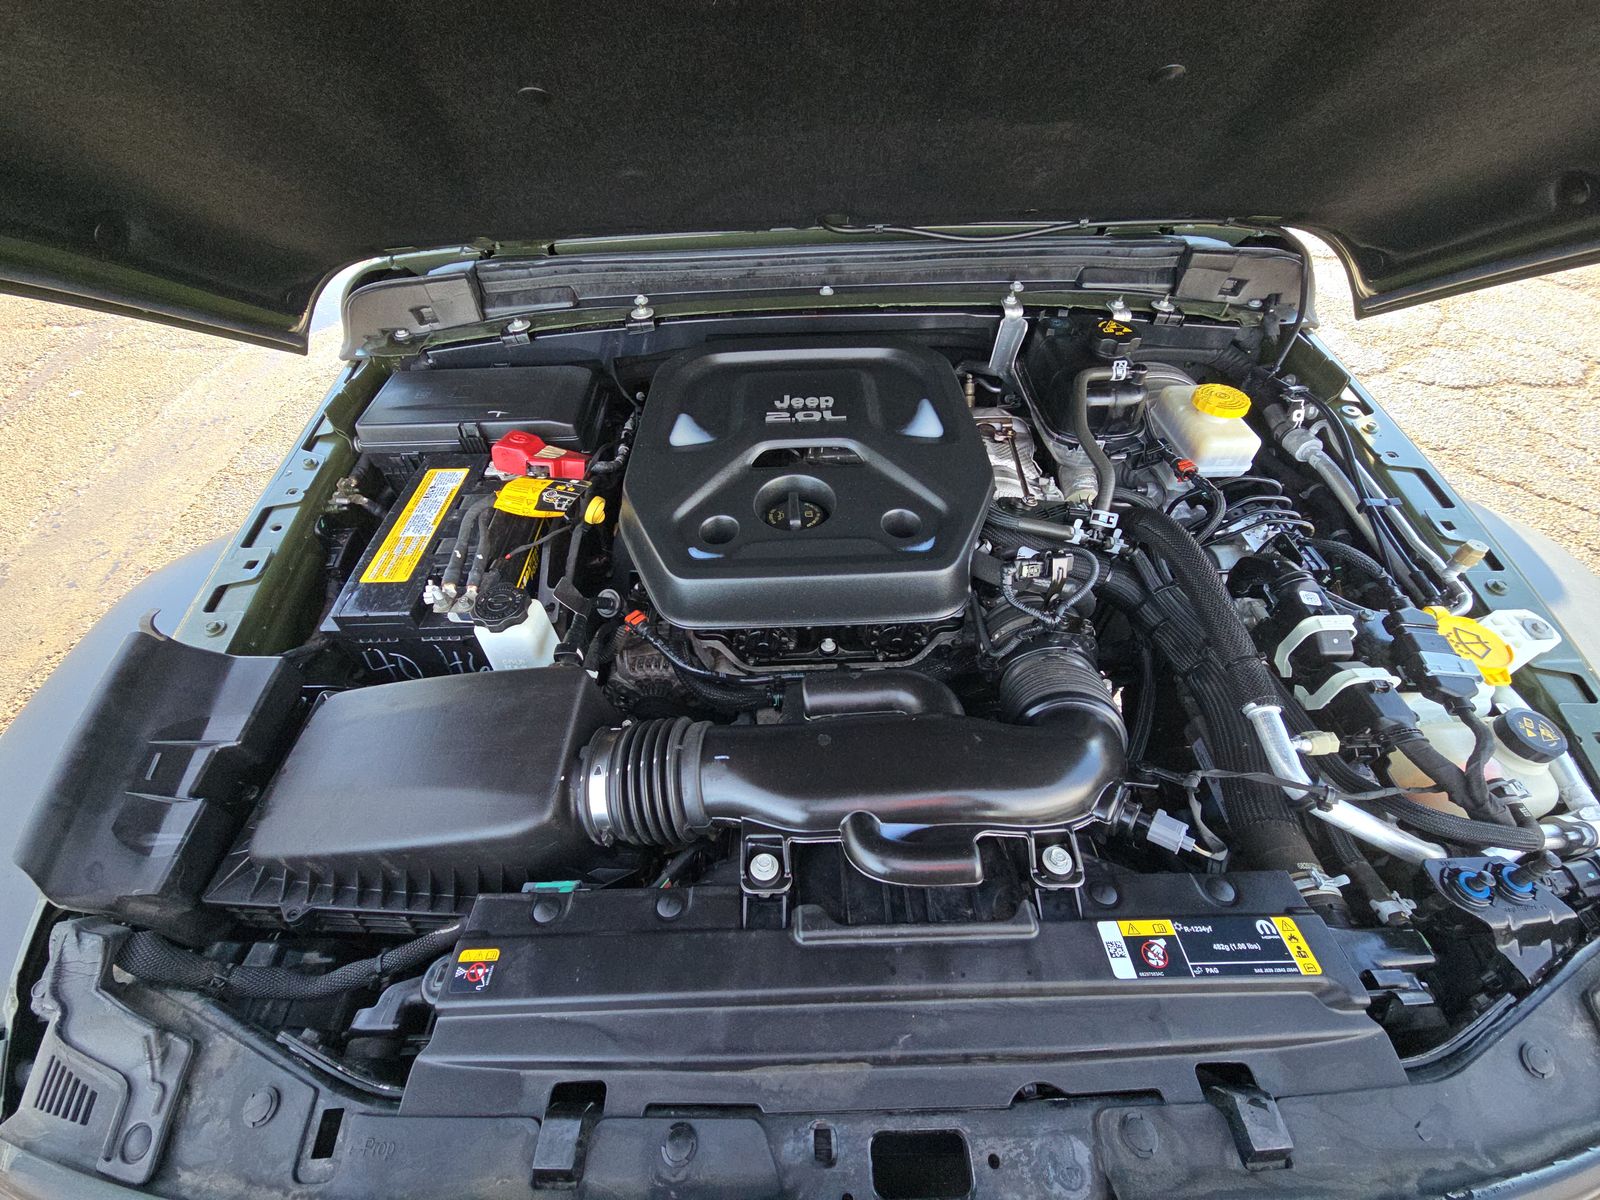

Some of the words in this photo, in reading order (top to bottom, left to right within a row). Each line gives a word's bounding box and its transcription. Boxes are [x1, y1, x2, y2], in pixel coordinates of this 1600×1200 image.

[774, 394, 835, 410] Jeep
[765, 410, 847, 424] 2.0L
[363, 1137, 396, 1161] Prop
